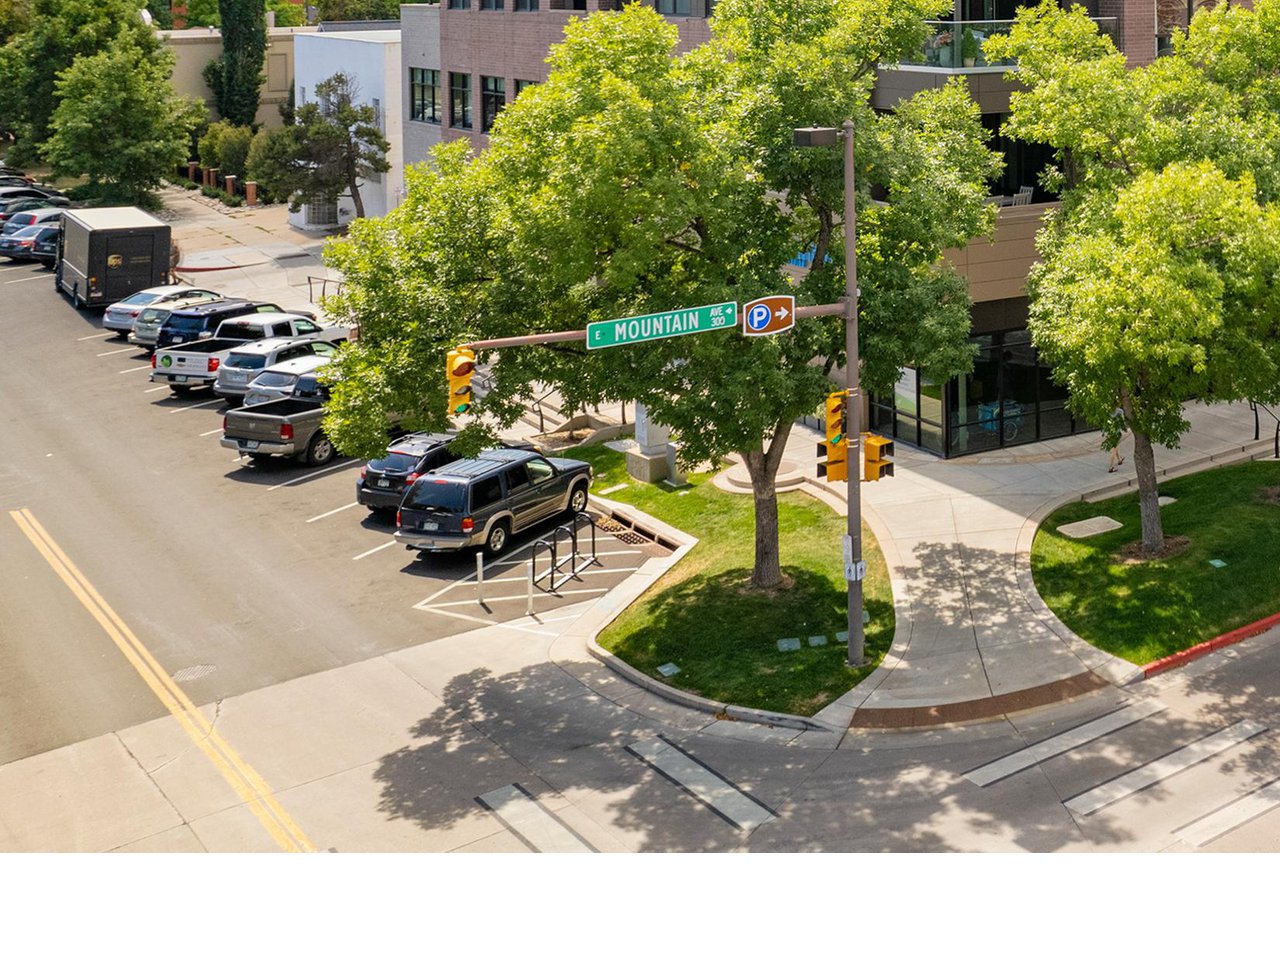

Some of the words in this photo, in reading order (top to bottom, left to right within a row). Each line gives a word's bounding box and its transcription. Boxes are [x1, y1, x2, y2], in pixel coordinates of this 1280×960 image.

[595, 330, 601, 340] E
[615, 311, 699, 341] MOUNTAIN
[710, 306, 724, 317] AVE
[711, 316, 726, 327] 300
[753, 307, 768, 328] P
